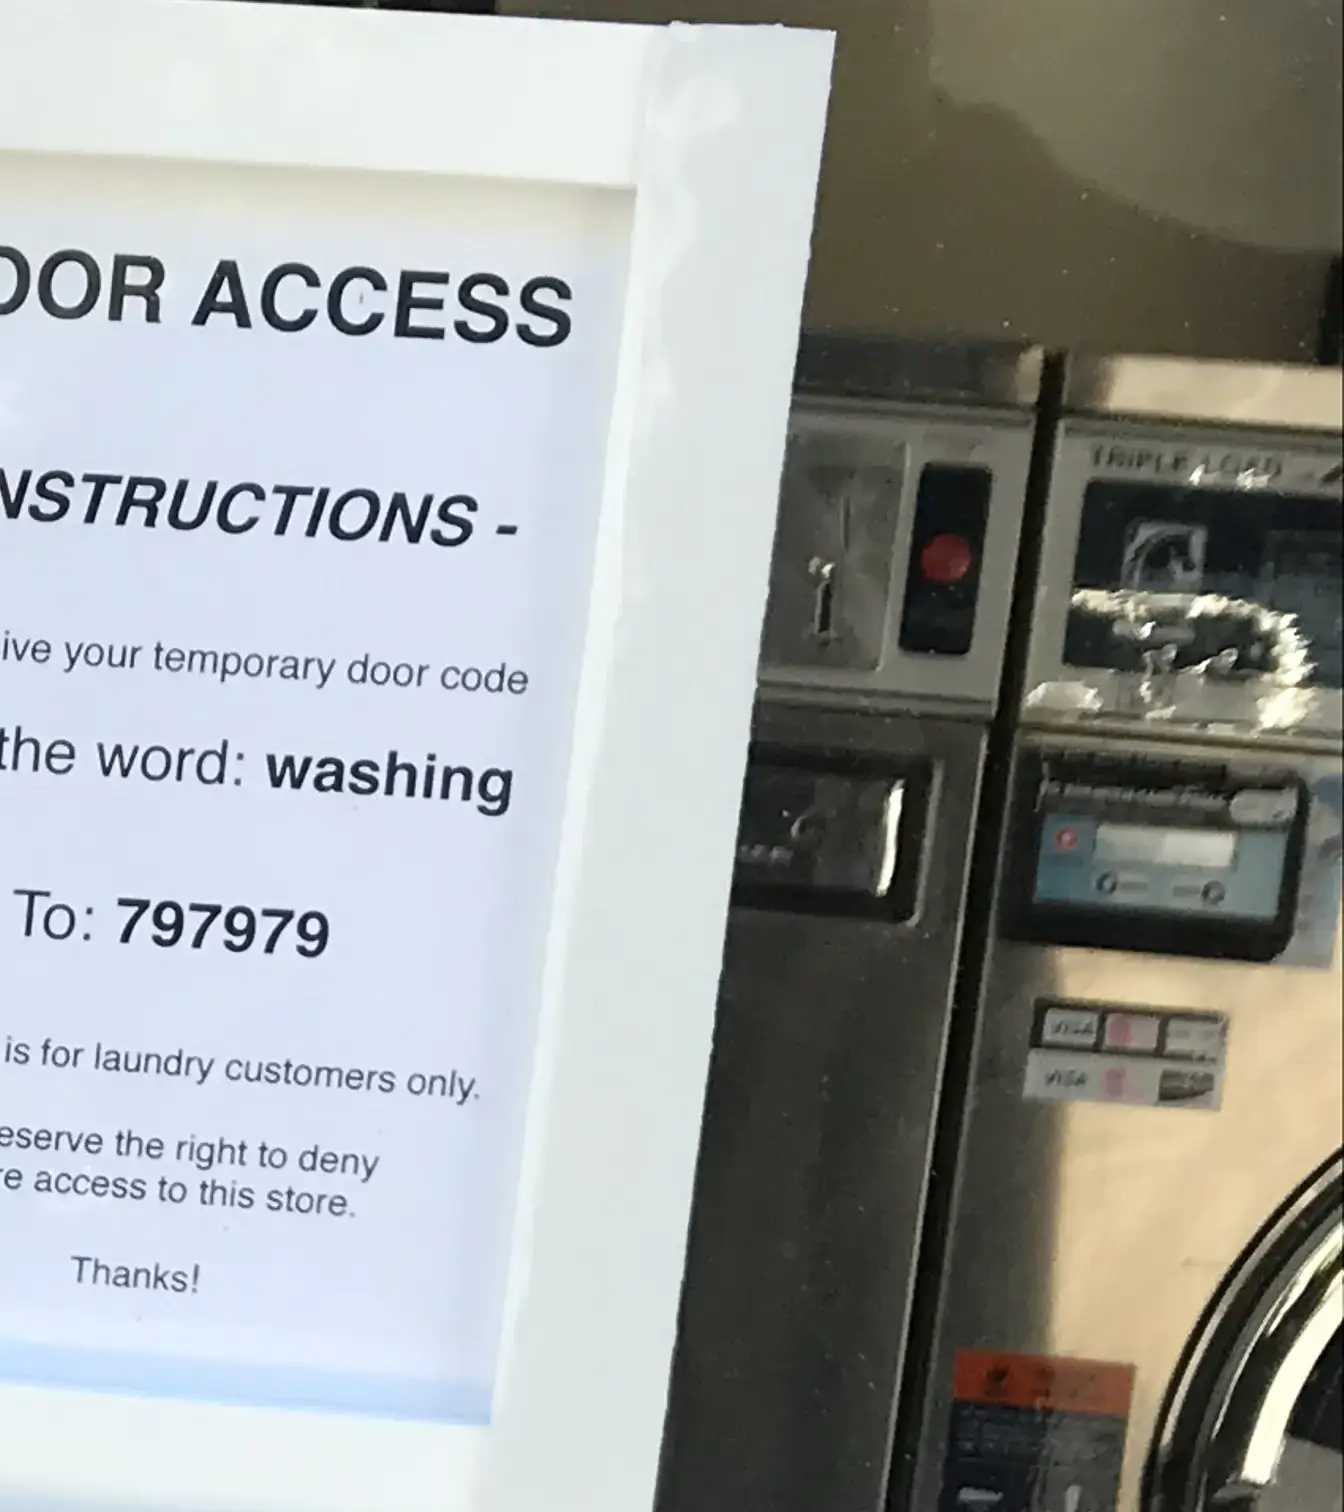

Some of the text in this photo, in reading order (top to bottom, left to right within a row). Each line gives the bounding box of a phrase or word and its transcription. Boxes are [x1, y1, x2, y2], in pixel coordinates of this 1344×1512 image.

[190, 258, 574, 349] ACCESS
[62, 641, 144, 674] your
[153, 640, 337, 690] temporary
[346, 652, 431, 688] door
[439, 661, 530, 696] code
[96, 738, 246, 787] word:
[265, 749, 514, 818] washing
[12, 888, 330, 960] To: 797979
[4, 1034, 31, 1066] is
[40, 1037, 85, 1069] for
[93, 1041, 216, 1086] laundry
[224, 1058, 397, 1094] customers
[406, 1068, 481, 1107] only.
[114, 1128, 165, 1161] the
[175, 1133, 249, 1172] right
[257, 1141, 289, 1170] to
[297, 1143, 381, 1184] deny
[33, 1170, 148, 1201] access
[157, 1175, 188, 1205] to
[199, 1178, 256, 1210] this
[265, 1185, 356, 1218] store.
[70, 1255, 200, 1294] Thanks!
